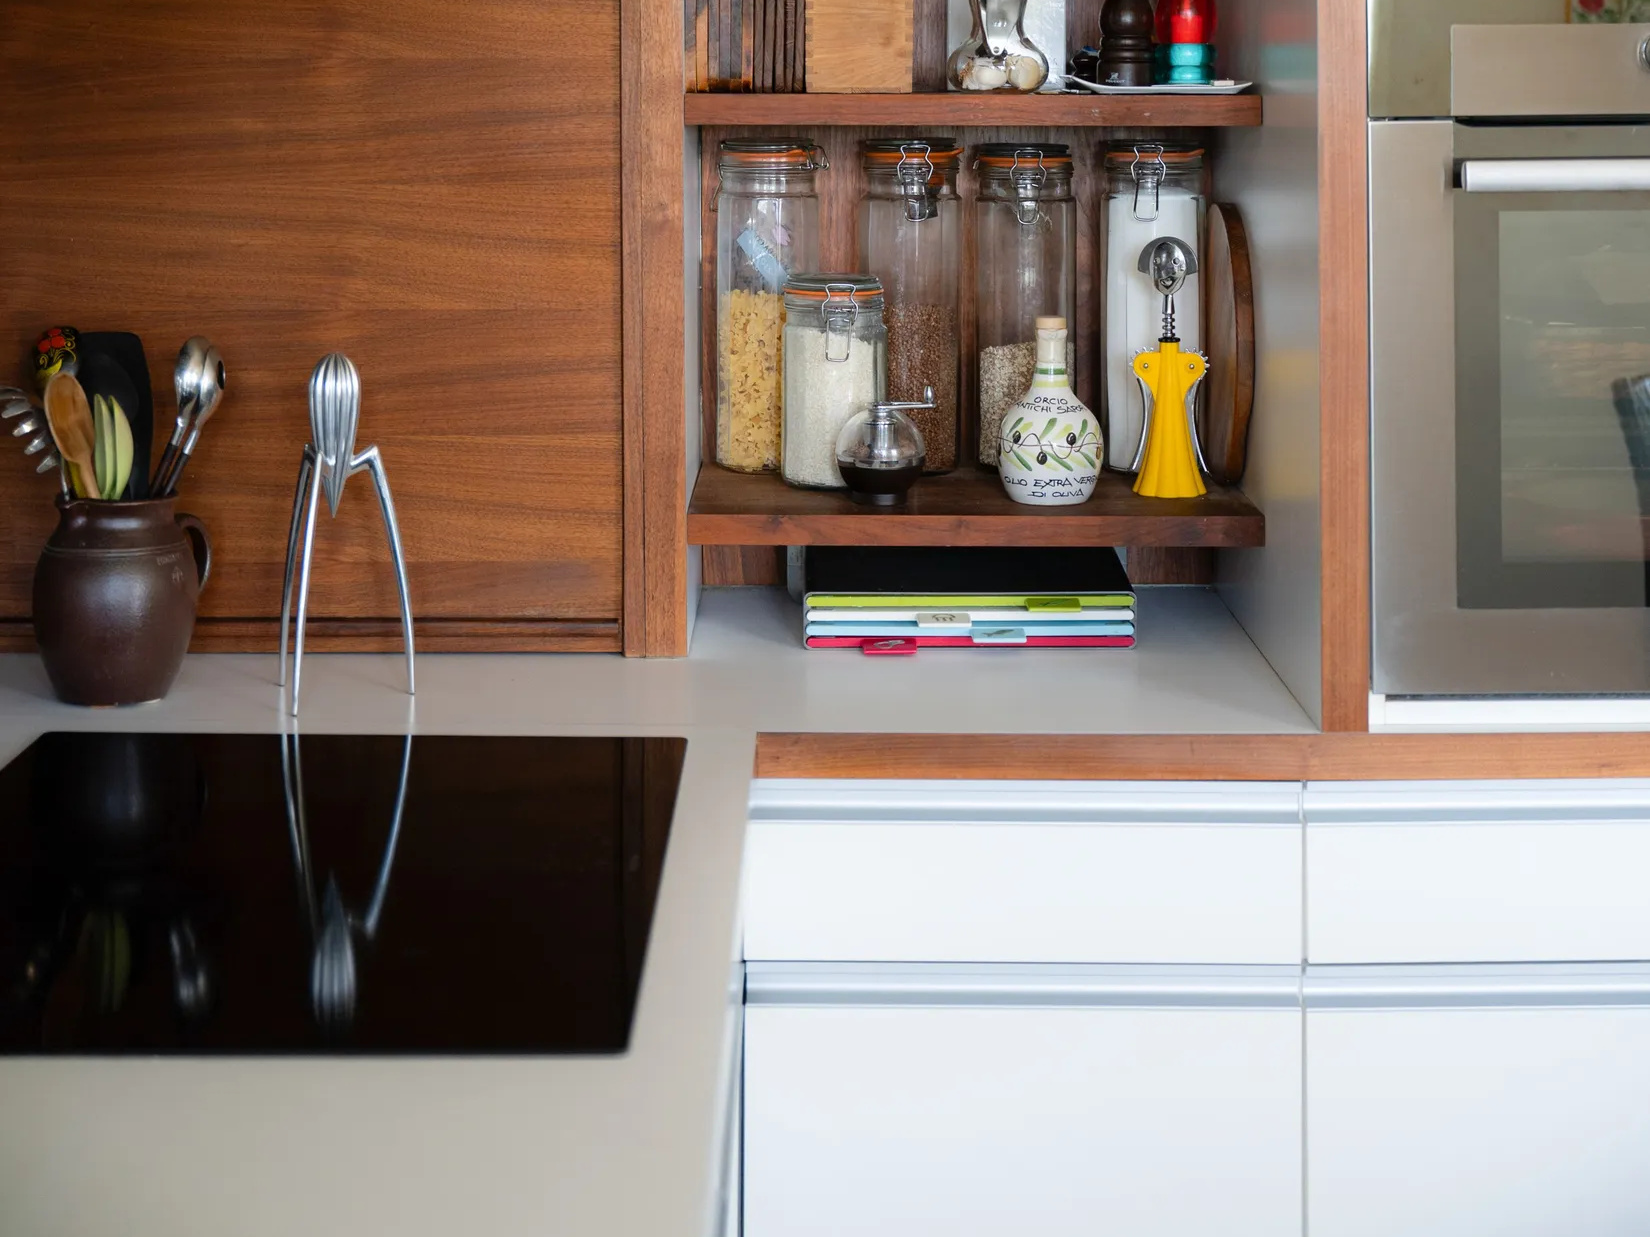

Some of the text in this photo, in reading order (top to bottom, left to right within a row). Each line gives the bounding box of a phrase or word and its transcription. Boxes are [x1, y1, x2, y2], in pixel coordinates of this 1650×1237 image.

[1034, 396, 1068, 405] ORCIO
[1015, 401, 1052, 412] ANTICHI
[1004, 476, 1027, 486] OLIO
[1033, 478, 1073, 489] EXTRA
[1052, 488, 1084, 497] OLIVA
